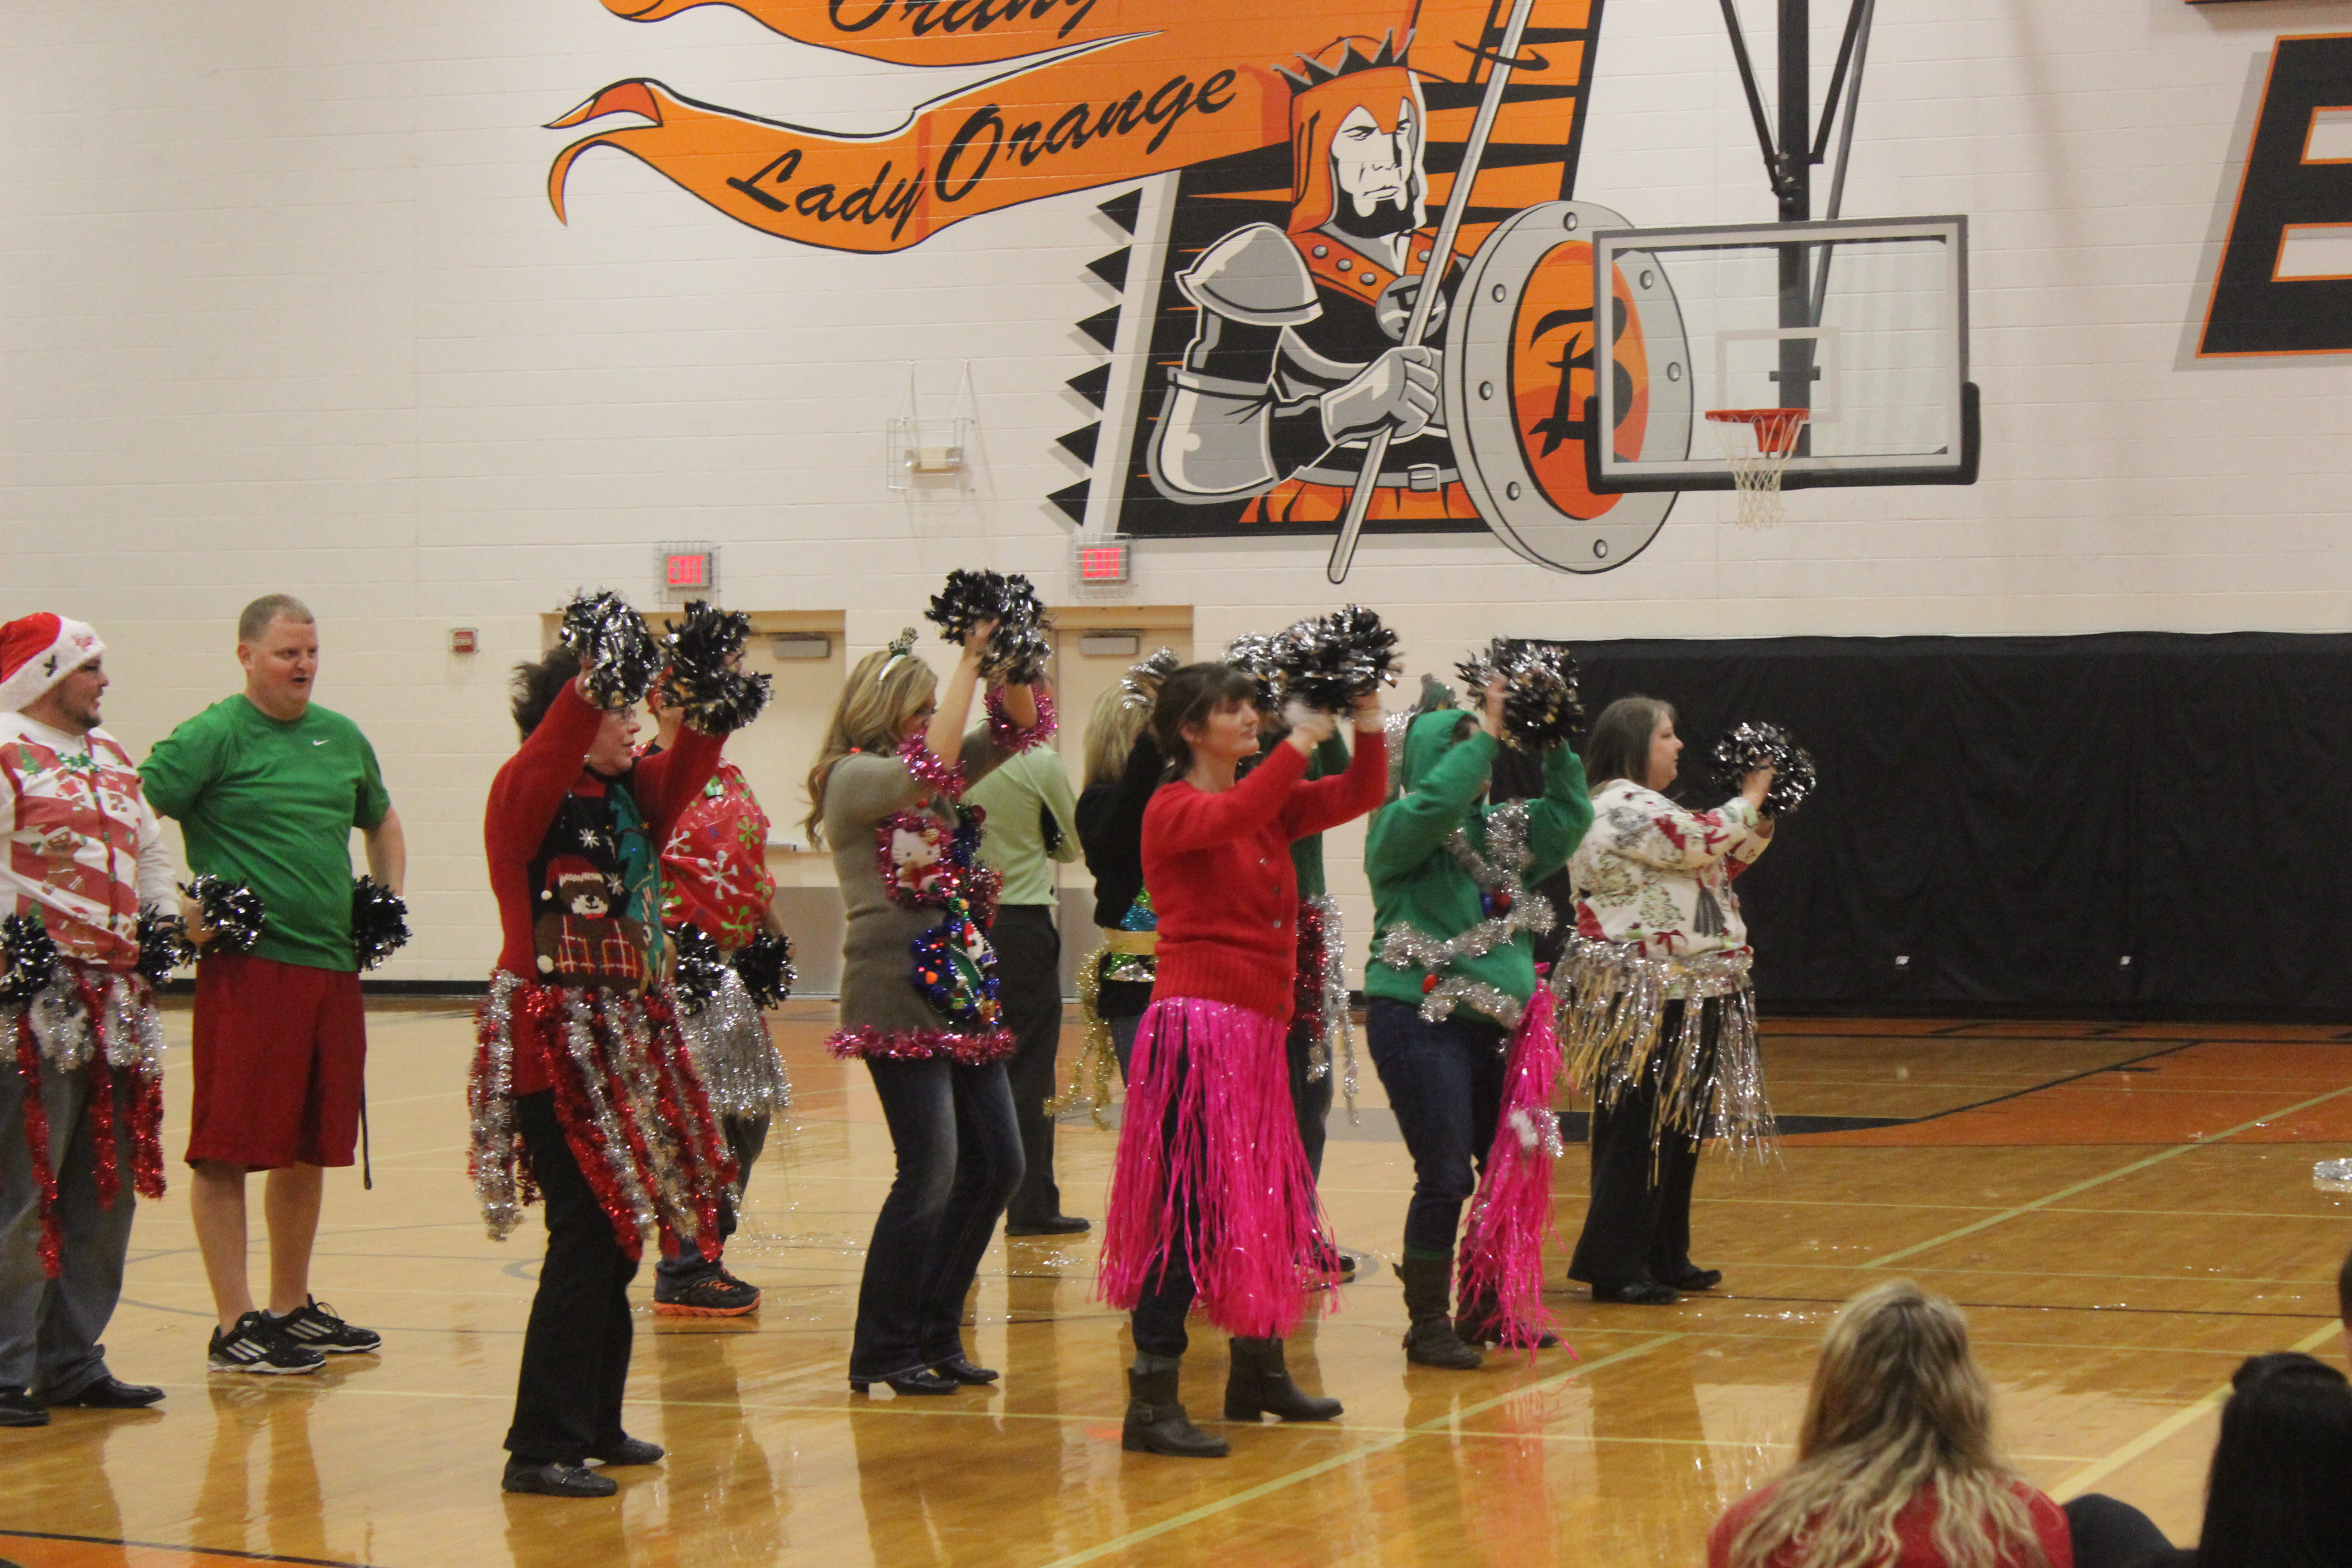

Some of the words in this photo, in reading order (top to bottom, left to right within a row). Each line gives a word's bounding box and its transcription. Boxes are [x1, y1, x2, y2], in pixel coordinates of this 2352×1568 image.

[726, 149, 926, 242] Lady
[935, 69, 1237, 202] Orange
[667, 555, 705, 584] EXIT
[1083, 548, 1122, 578] EXIT
